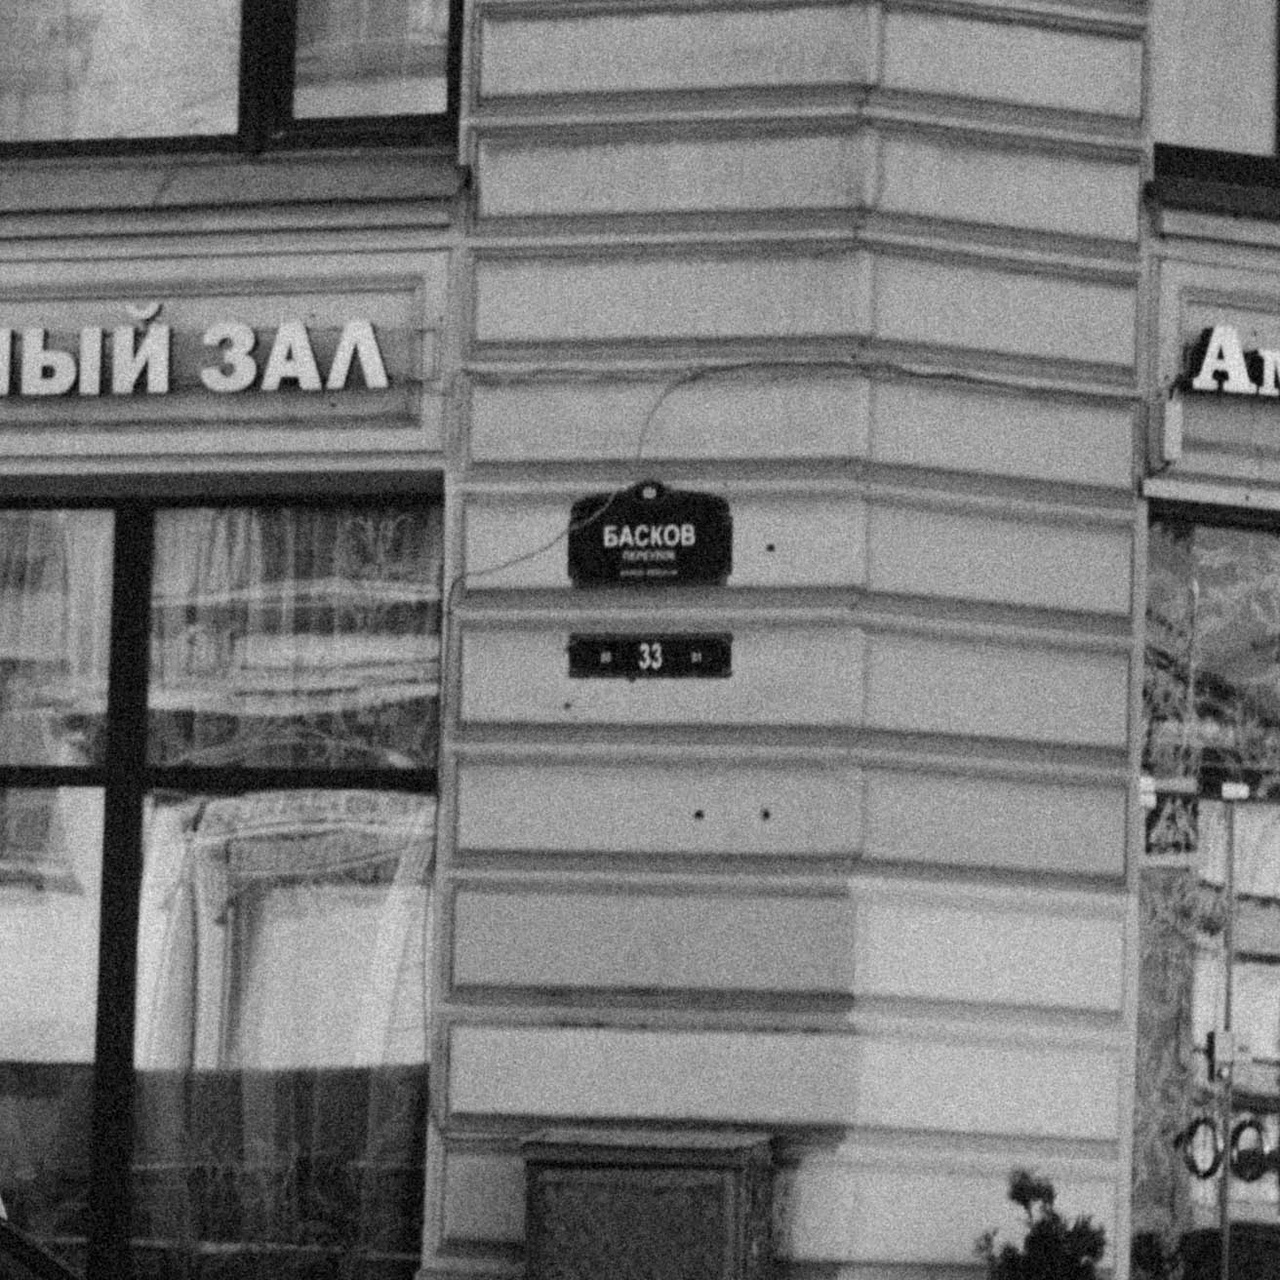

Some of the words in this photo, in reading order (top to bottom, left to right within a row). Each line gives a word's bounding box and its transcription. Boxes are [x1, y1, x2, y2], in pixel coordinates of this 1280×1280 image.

[199, 319, 389, 394] ЗАЛ
[602, 523, 696, 548] БАСКОВ
[638, 642, 663, 670] 33
